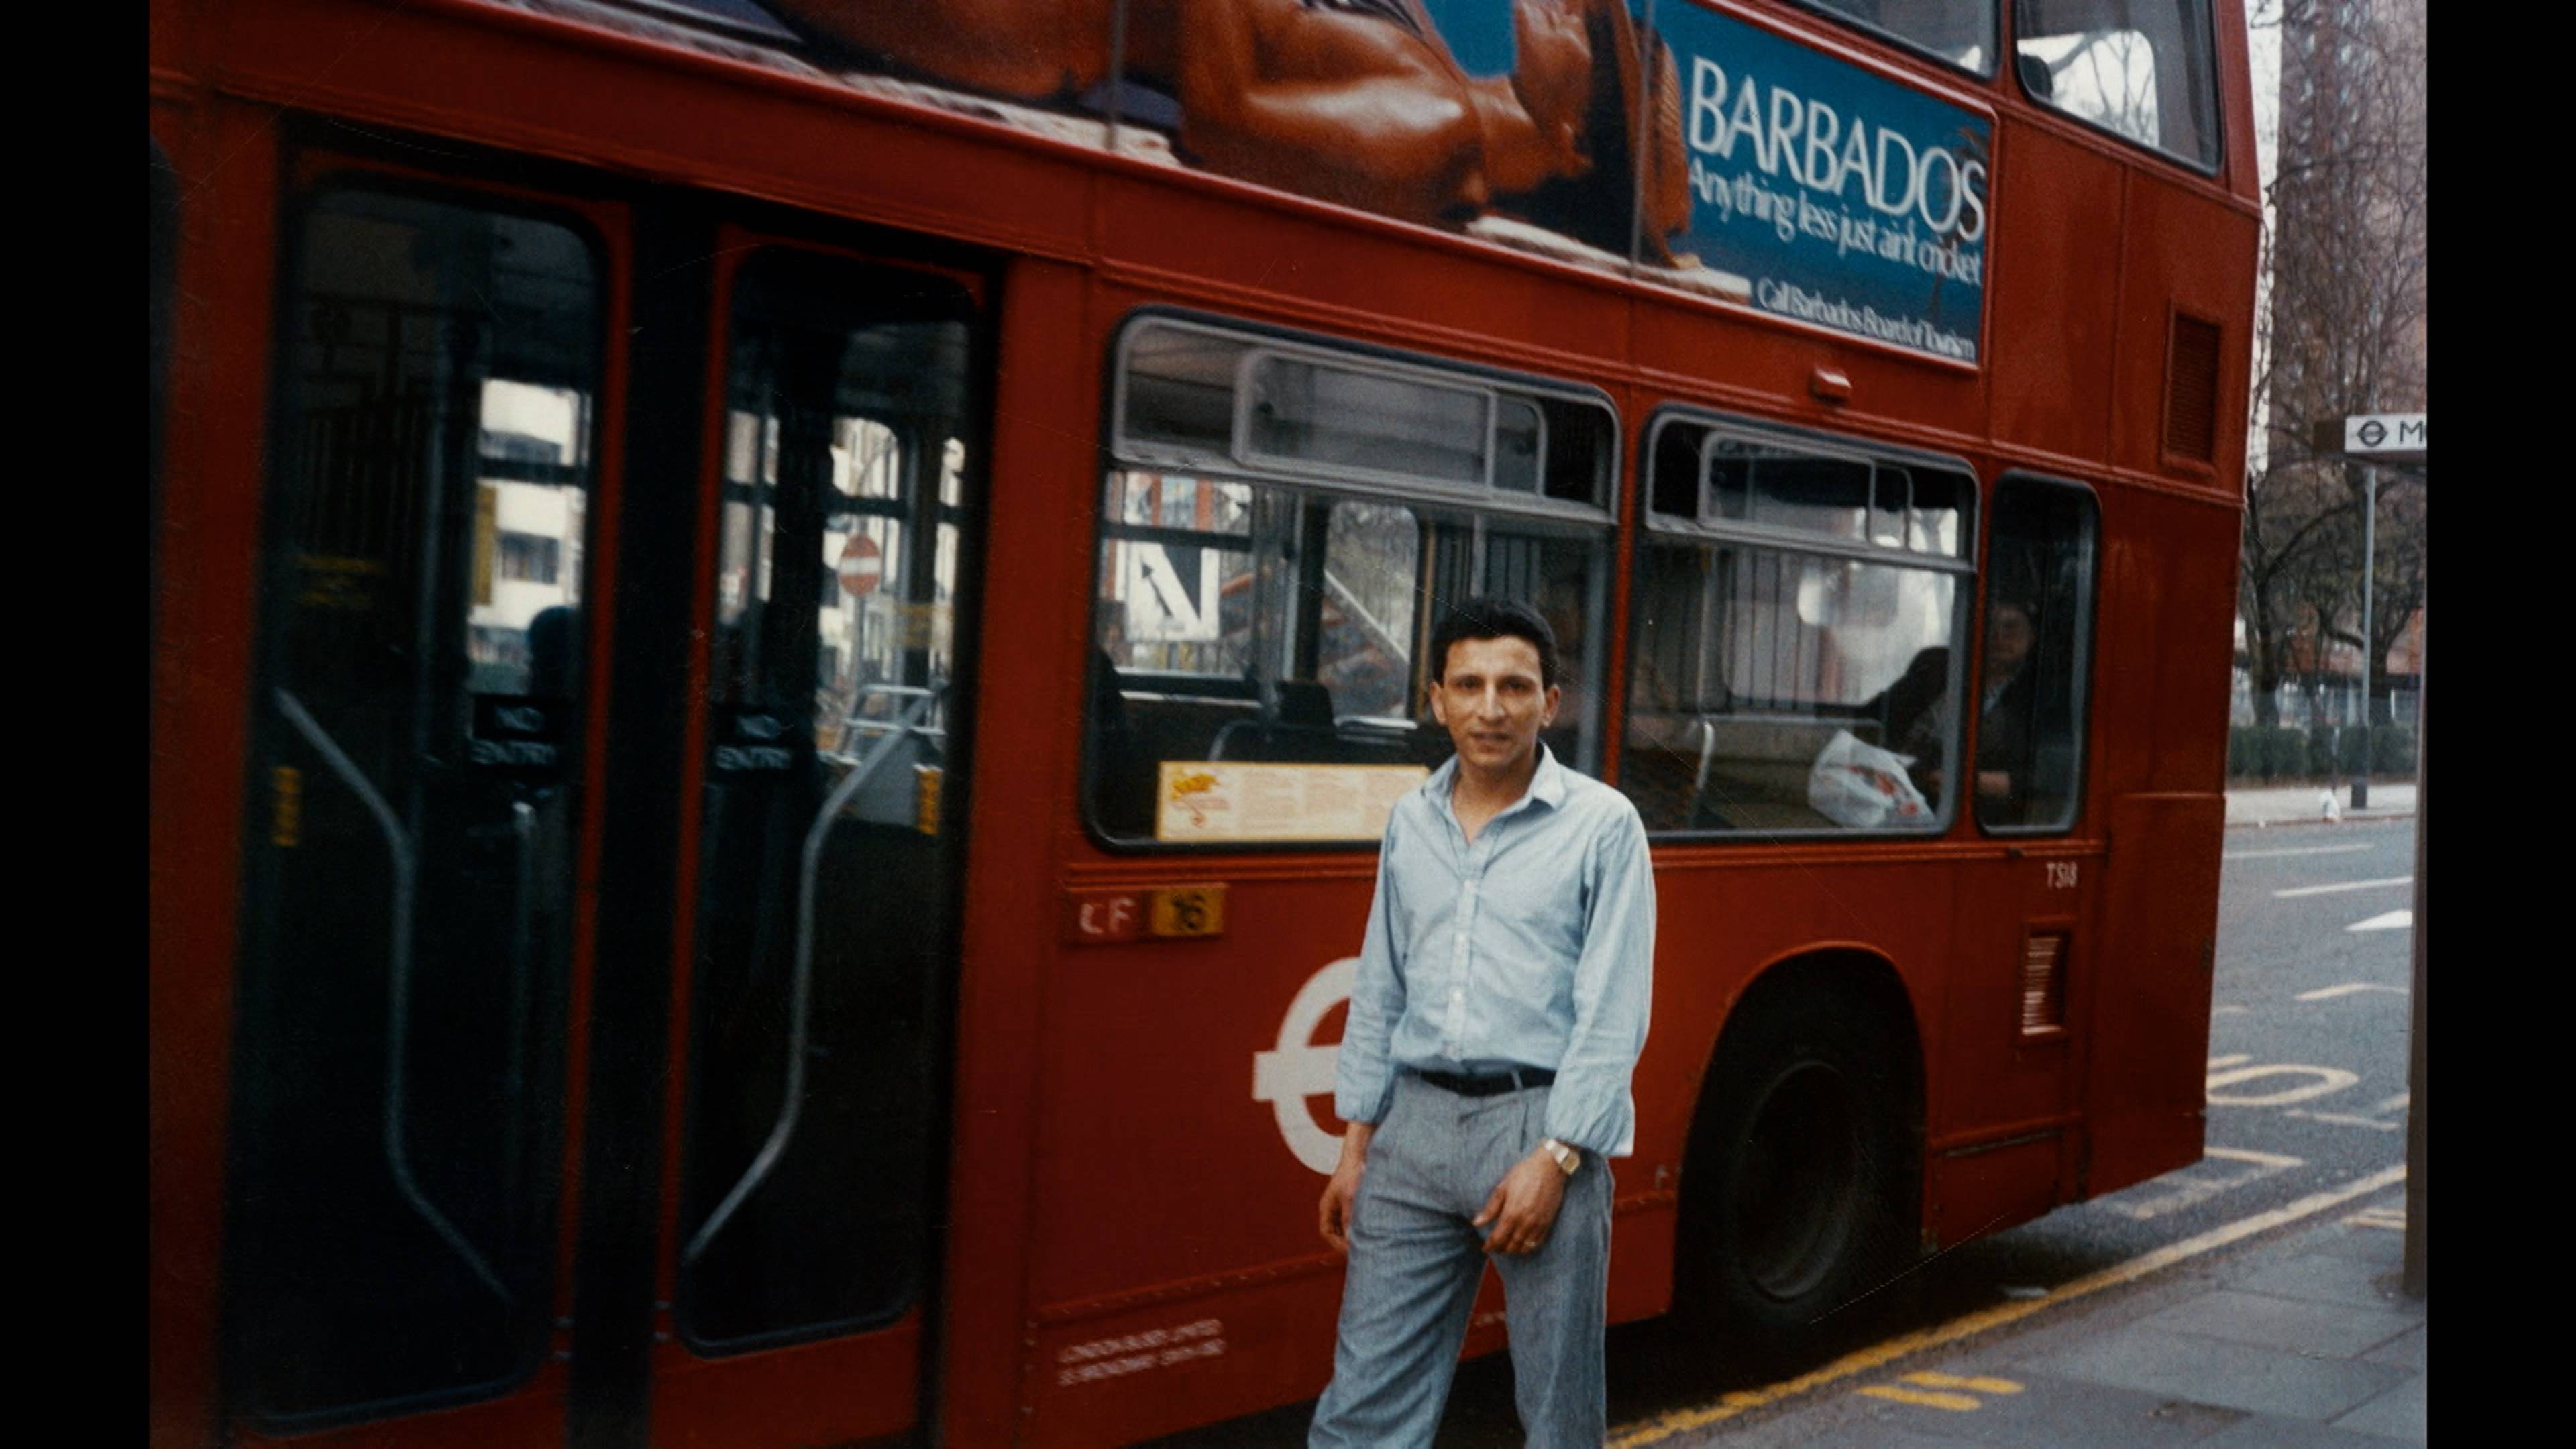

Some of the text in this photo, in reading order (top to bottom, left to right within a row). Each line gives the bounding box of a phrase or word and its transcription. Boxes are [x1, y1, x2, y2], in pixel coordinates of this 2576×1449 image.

[1690, 54, 1986, 243] BARBADOS
[1689, 158, 1796, 242] Anything
[1799, 189, 1838, 241] less
[1838, 204, 1876, 258] just
[1919, 235, 1981, 286] cricket
[1757, 278, 1792, 312] Call
[1790, 285, 1862, 331] Barbados
[1863, 305, 1913, 347] Board
[1919, 319, 1976, 360] Tourism
[2400, 421, 2426, 443] M
